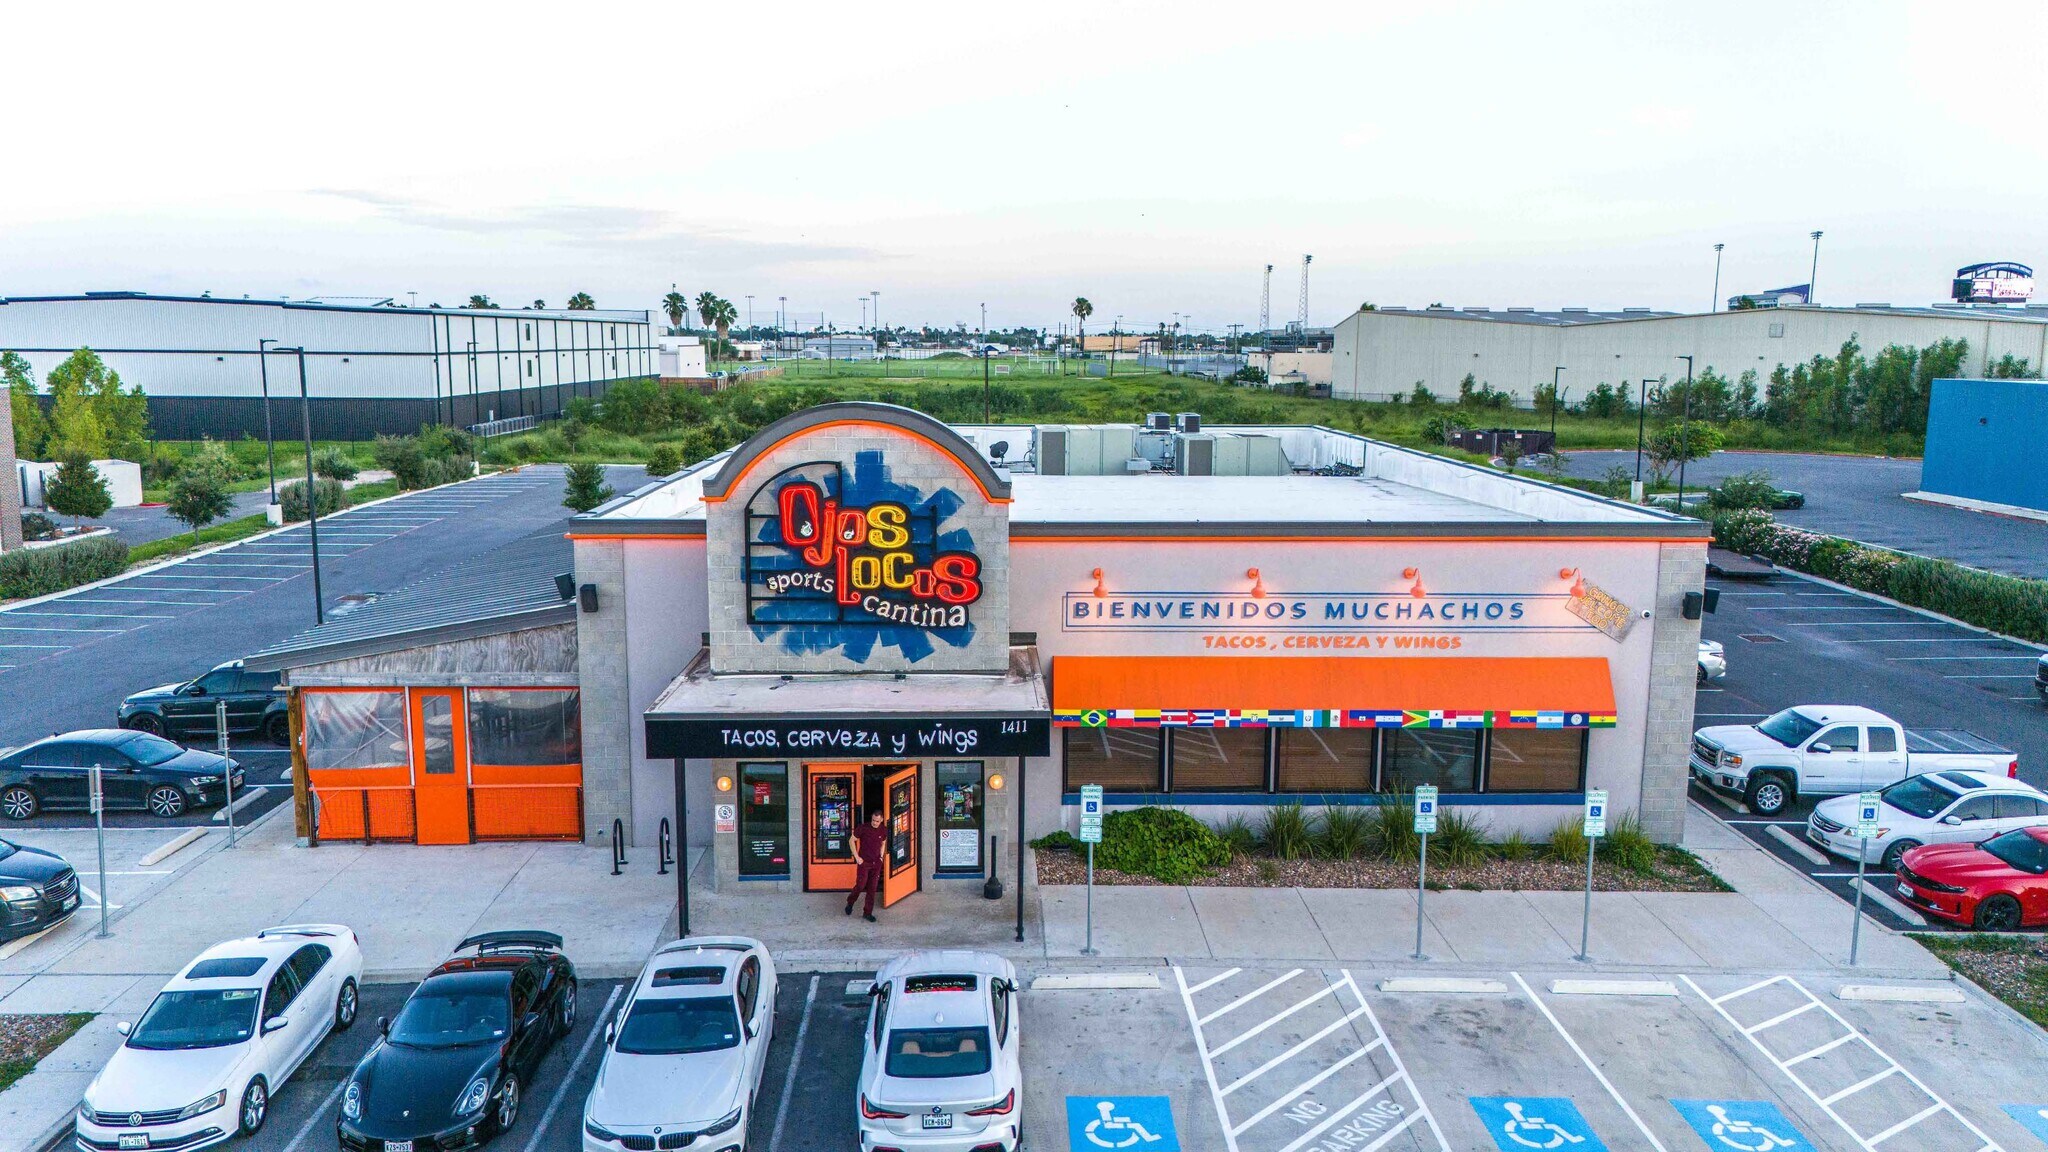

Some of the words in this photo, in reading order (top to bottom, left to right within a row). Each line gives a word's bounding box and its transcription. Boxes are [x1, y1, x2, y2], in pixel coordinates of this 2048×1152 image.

[767, 571, 835, 595] sports
[863, 595, 968, 628] cantina
[1073, 601, 1307, 619] BIENVENIDOS
[1325, 602, 1524, 620] MUCHACHOS
[1589, 587, 1631, 617] GRINGOS
[1586, 609, 1608, 630] TOO
[1283, 635, 1371, 649] CERVEZA
[1376, 636, 1388, 649] Y
[1394, 636, 1462, 649] WINGS
[1001, 720, 1028, 734] 1411
[721, 729, 780, 748] TACOS,
[1283, 1099, 1328, 1125] NO
[1305, 1099, 1405, 1152] ARKING
